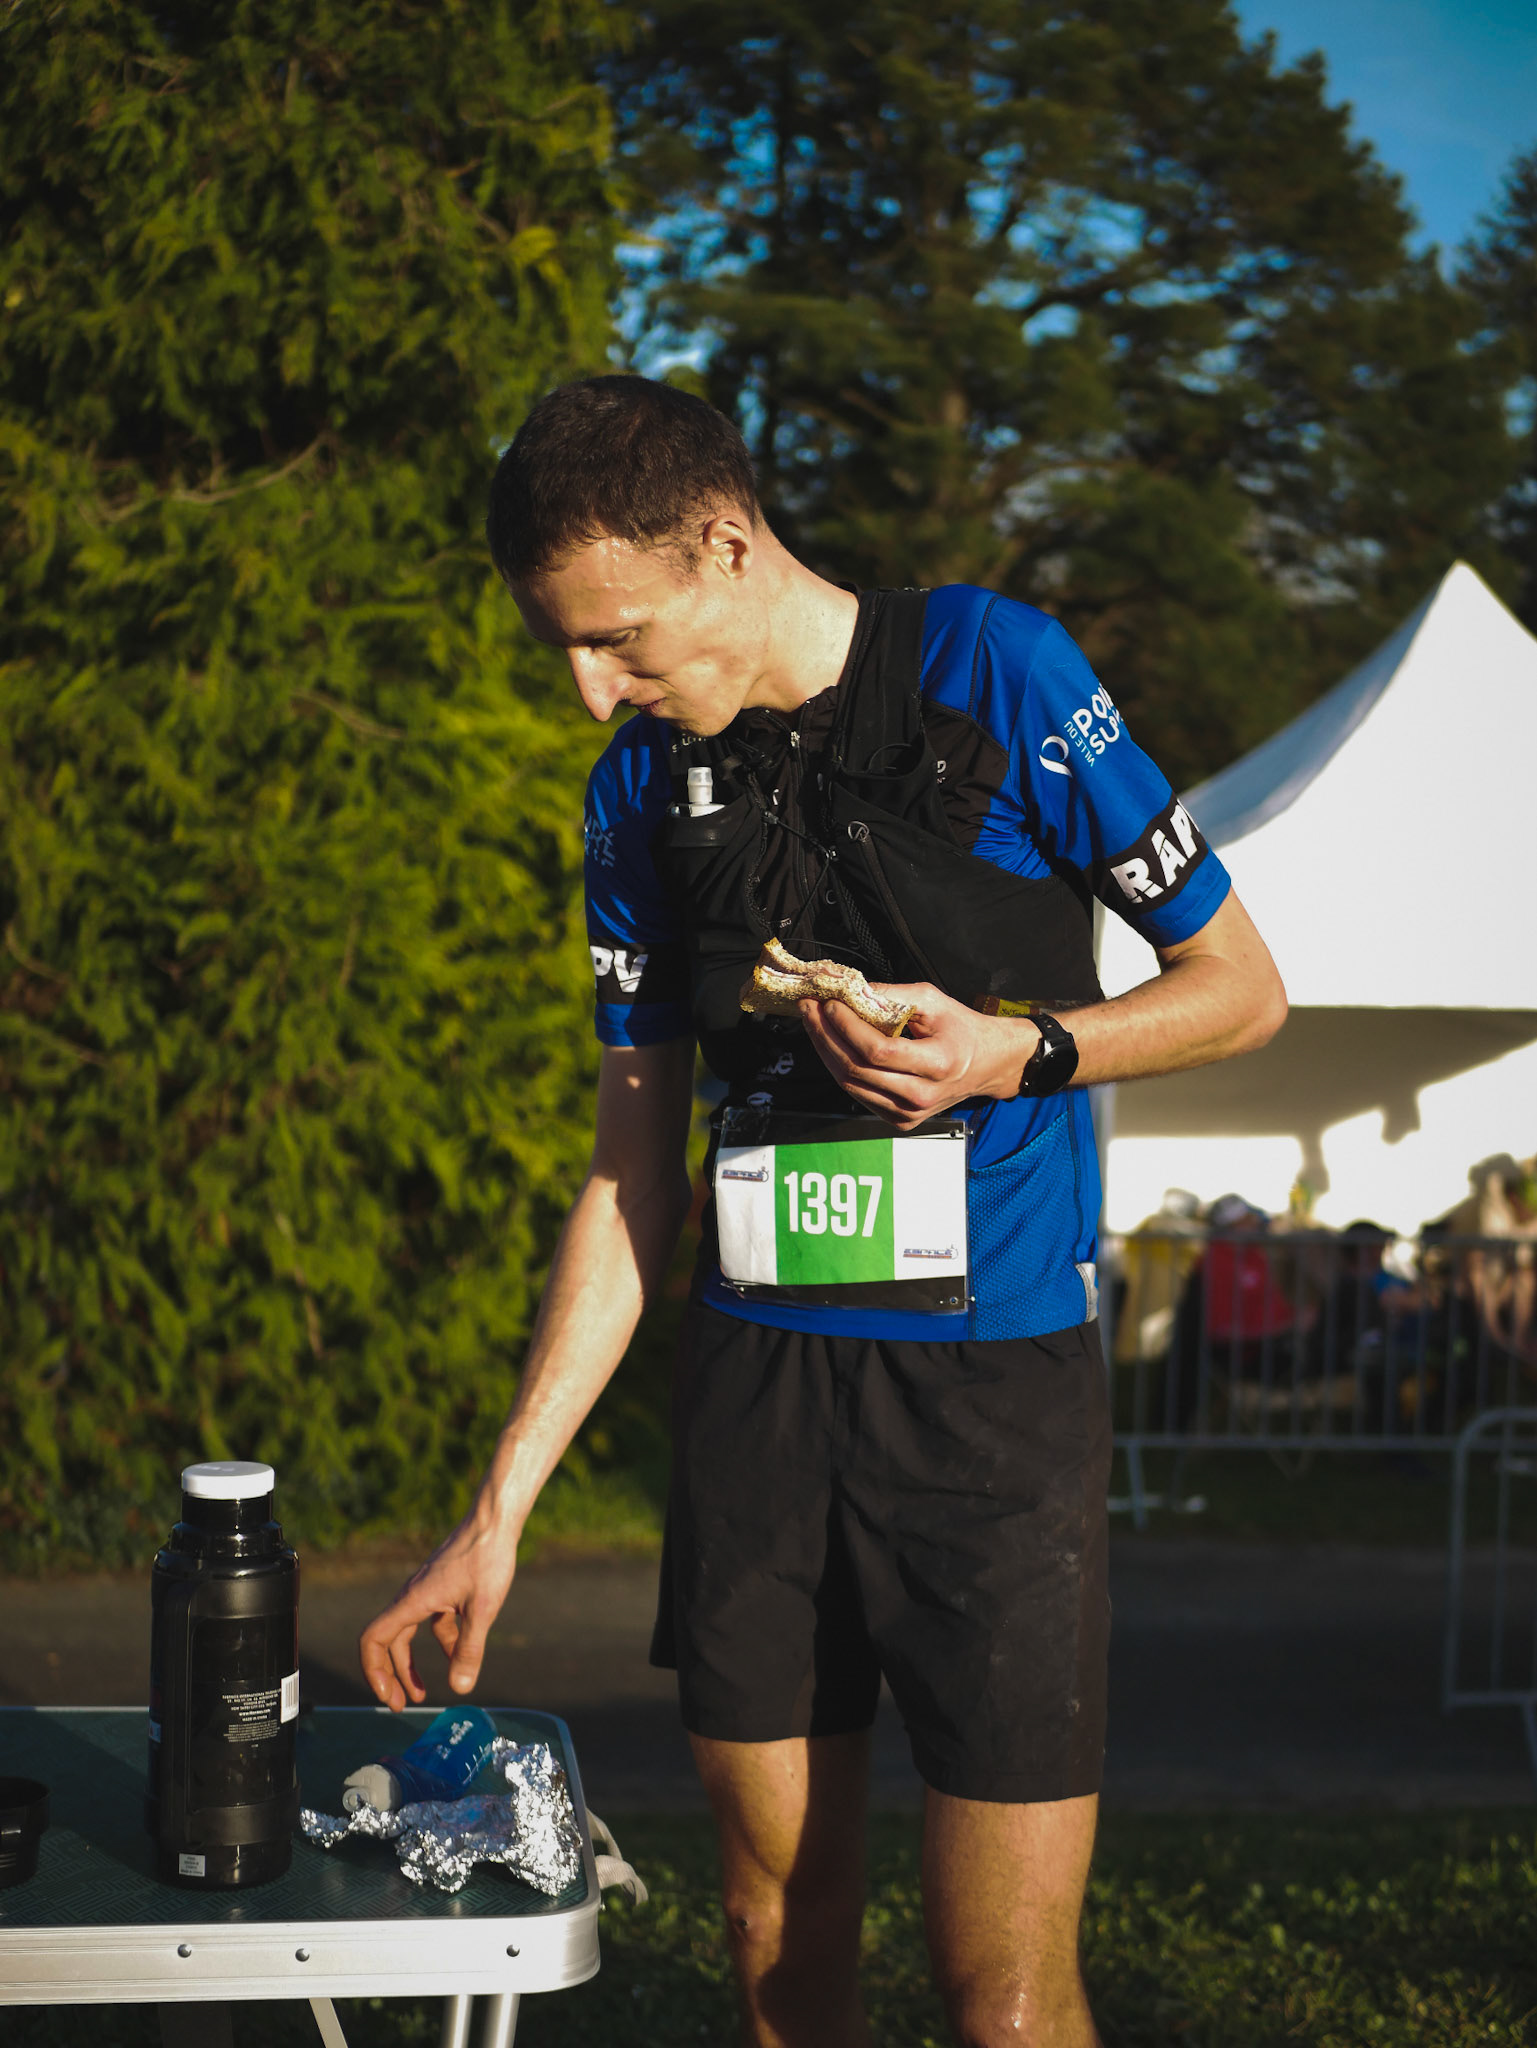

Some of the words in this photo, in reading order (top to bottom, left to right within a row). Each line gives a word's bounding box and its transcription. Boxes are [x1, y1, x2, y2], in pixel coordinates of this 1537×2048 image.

[1063, 721, 1078, 739] DU
[1110, 799, 1200, 904] RAP
[784, 1171, 882, 1238] 1397
